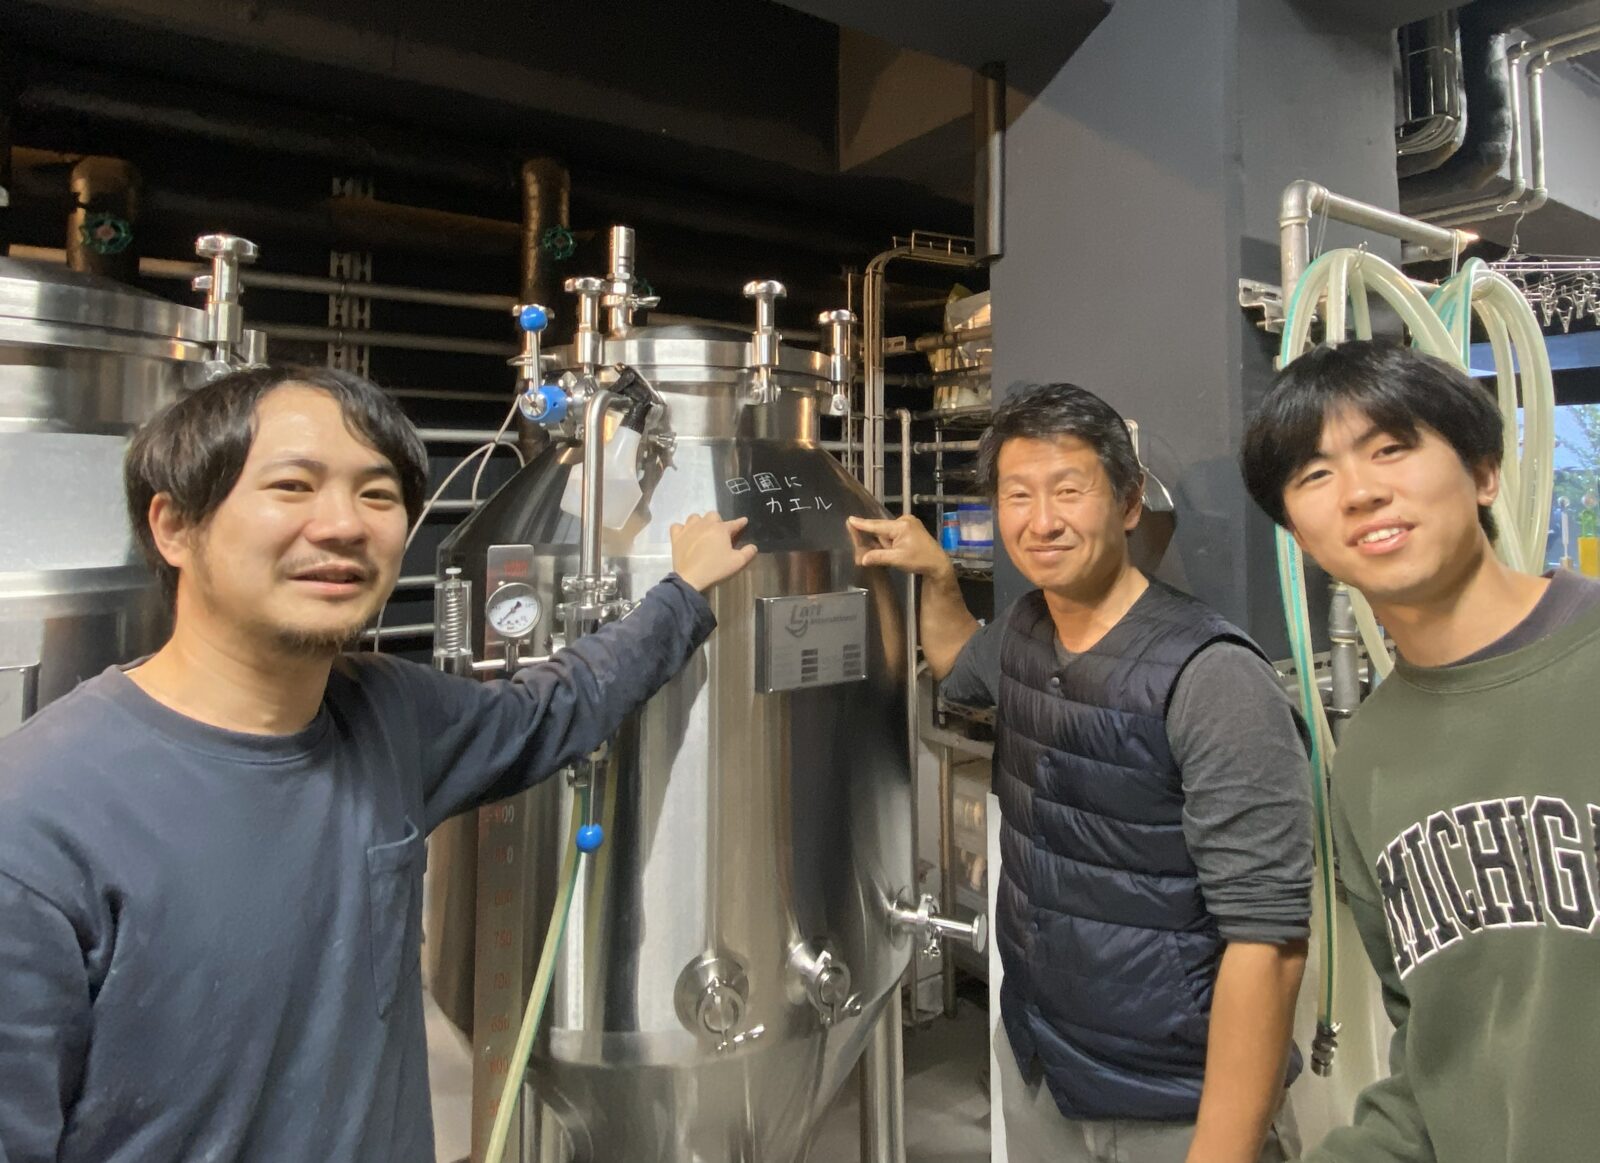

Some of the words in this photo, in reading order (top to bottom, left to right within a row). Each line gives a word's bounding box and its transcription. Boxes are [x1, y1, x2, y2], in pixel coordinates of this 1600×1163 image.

[725, 472, 802, 494] 田園に
[765, 496, 833, 514] カエル
[1376, 795, 1600, 980] MICHIG
